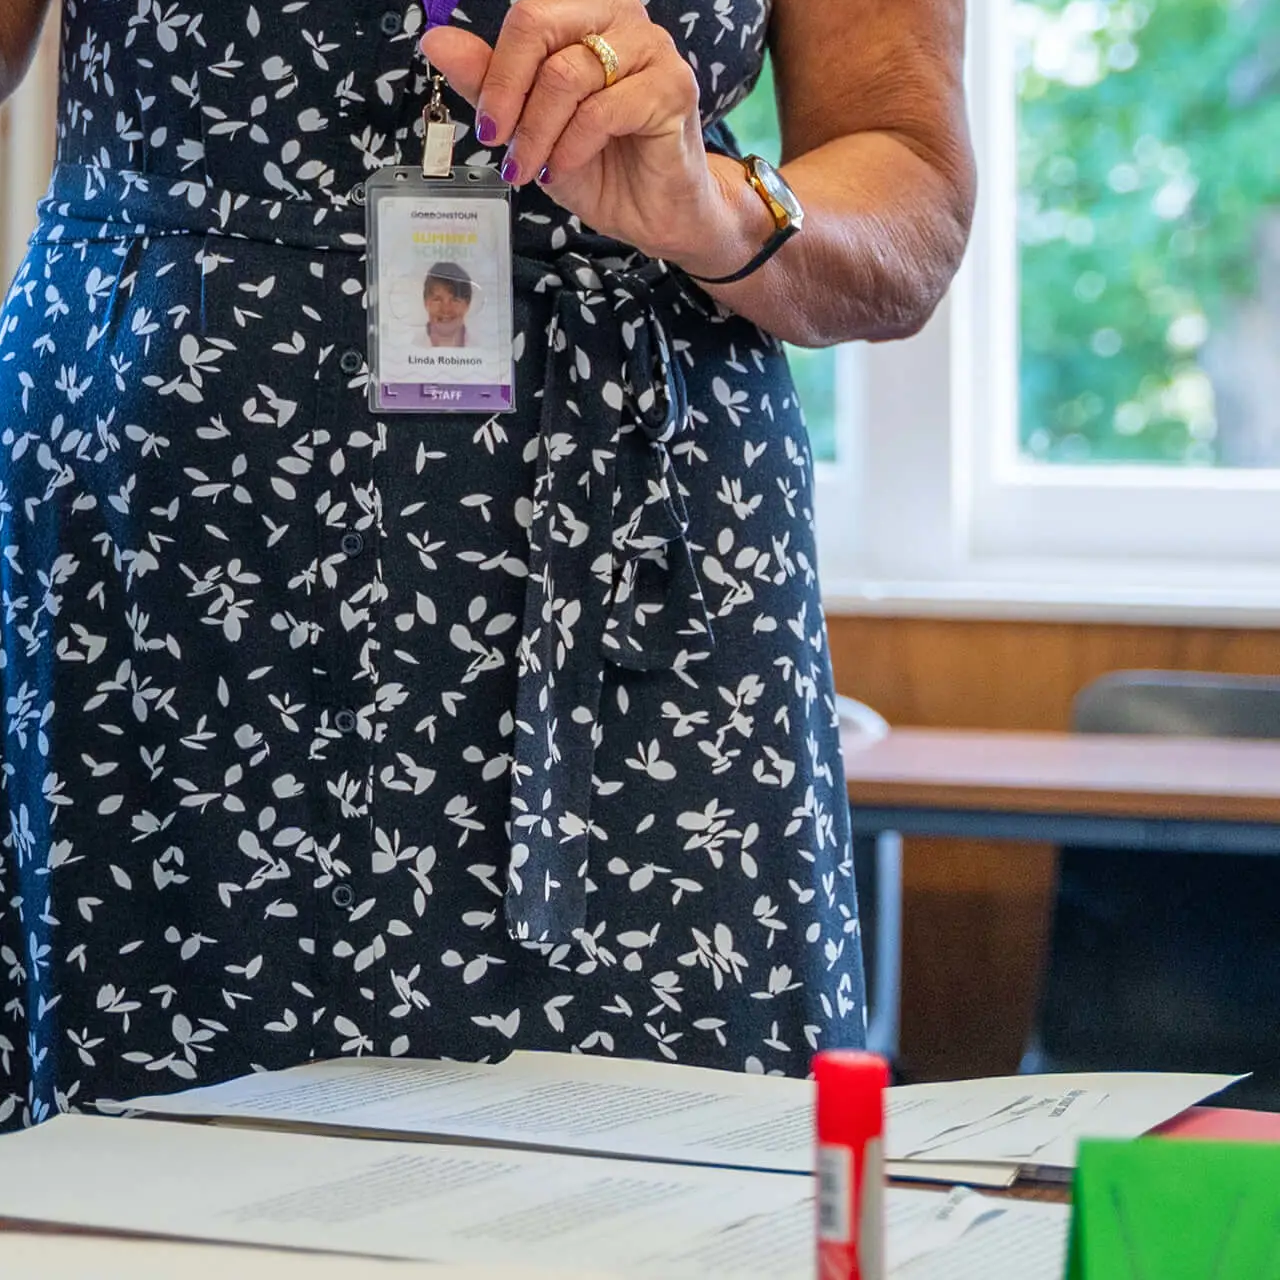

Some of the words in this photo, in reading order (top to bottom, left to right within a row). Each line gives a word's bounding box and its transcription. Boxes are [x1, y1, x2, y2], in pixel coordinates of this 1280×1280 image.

[410, 210, 478, 220] GORDONSTOUN
[407, 354, 435, 365] Linda
[438, 355, 483, 365] Robinson
[431, 390, 463, 401] STAFF
